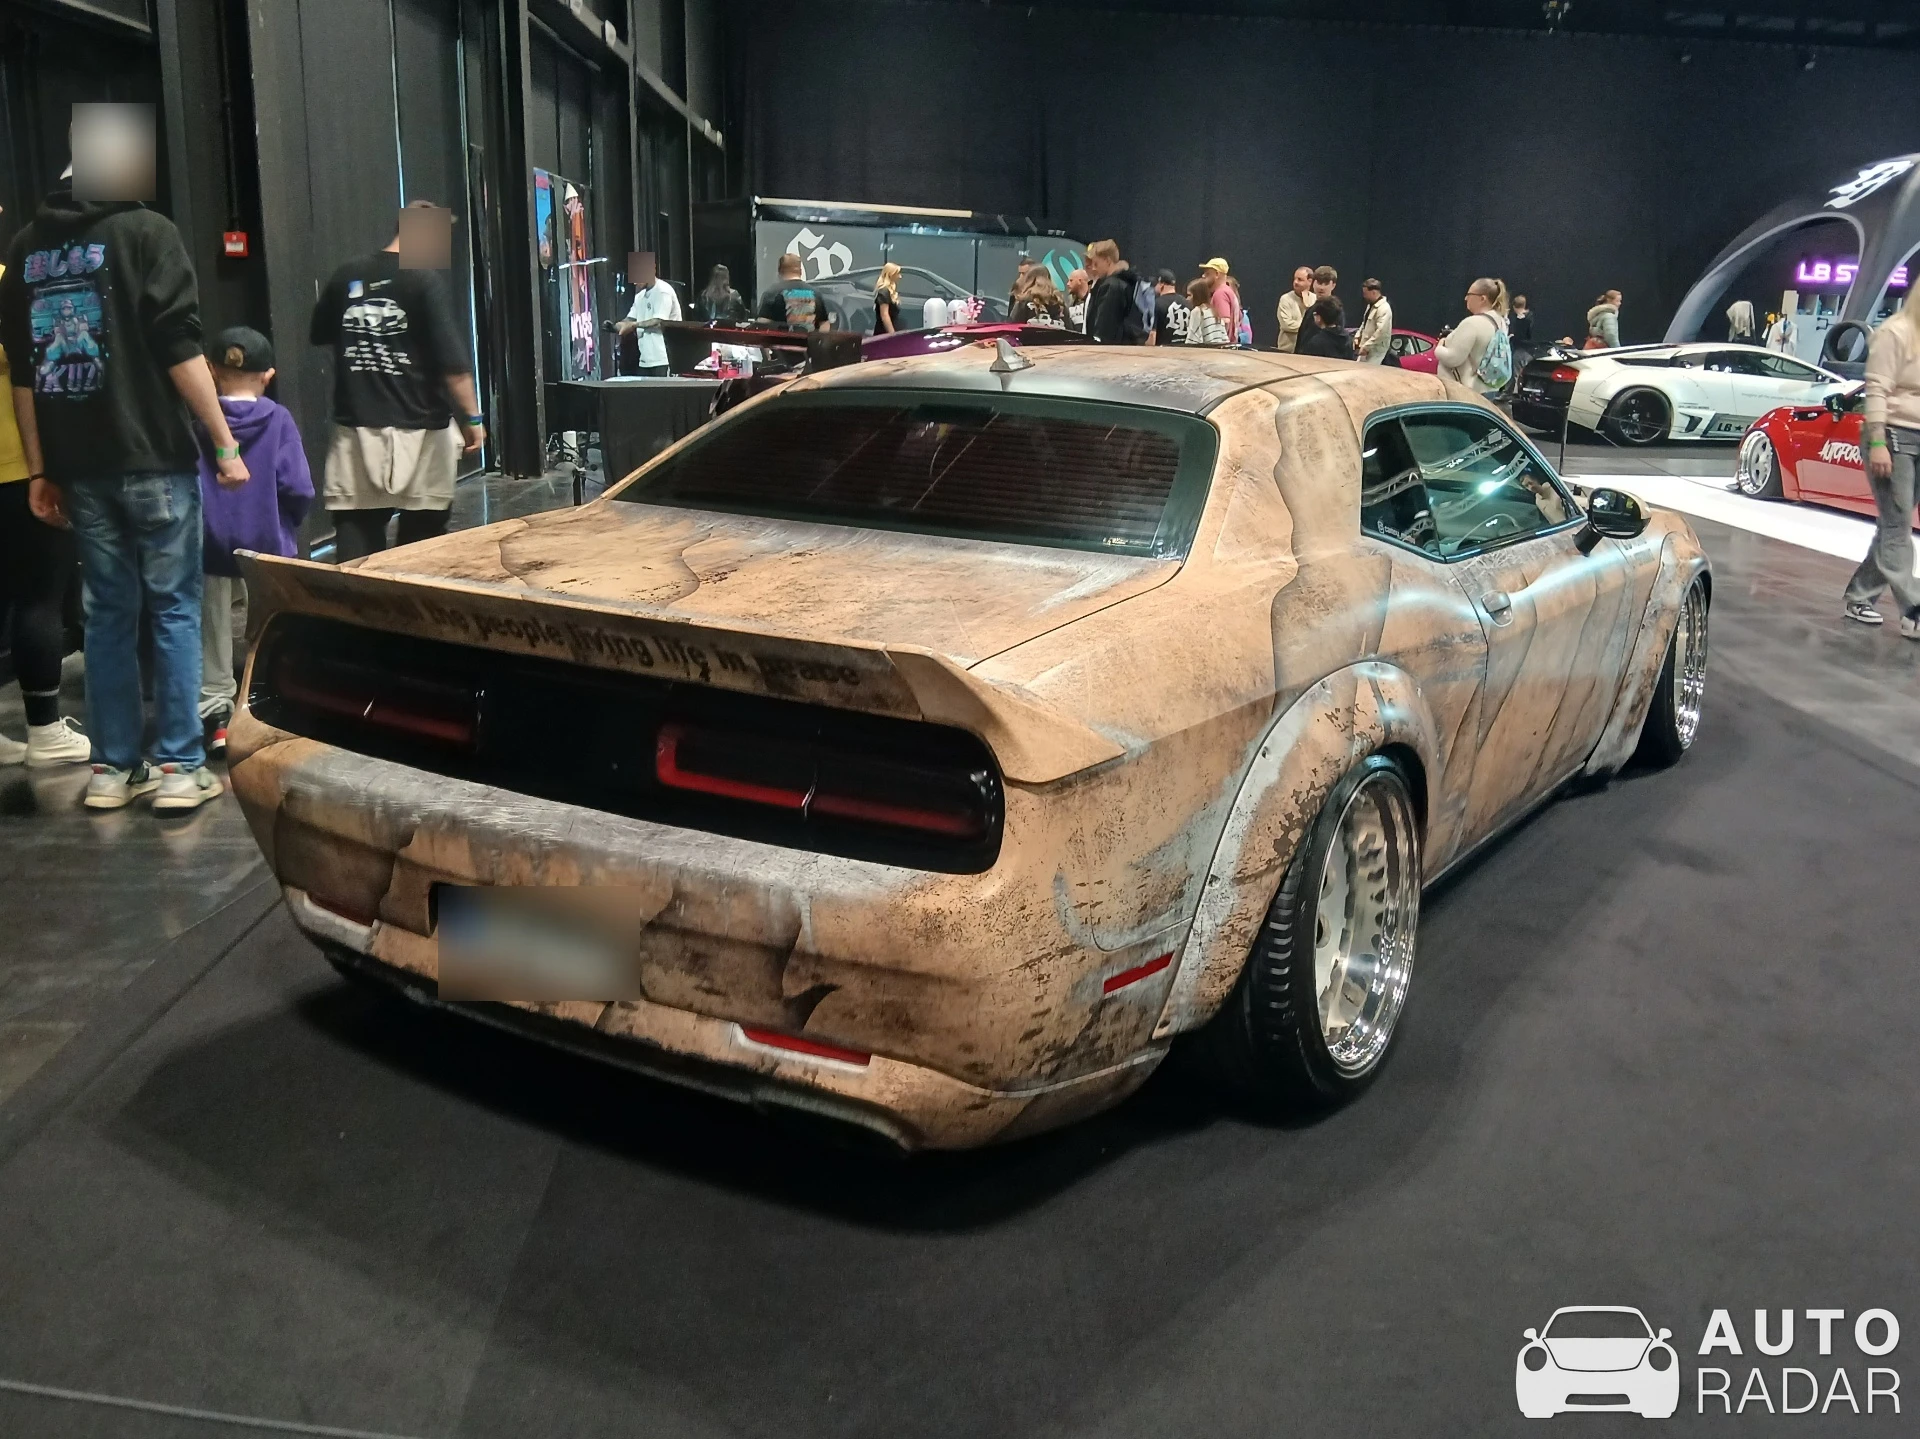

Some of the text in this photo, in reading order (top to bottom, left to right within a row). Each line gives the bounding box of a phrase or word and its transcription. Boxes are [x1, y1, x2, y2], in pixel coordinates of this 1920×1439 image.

[1798, 262, 1831, 283] LB
[1716, 422, 1733, 432] LB
[471, 607, 568, 650] people
